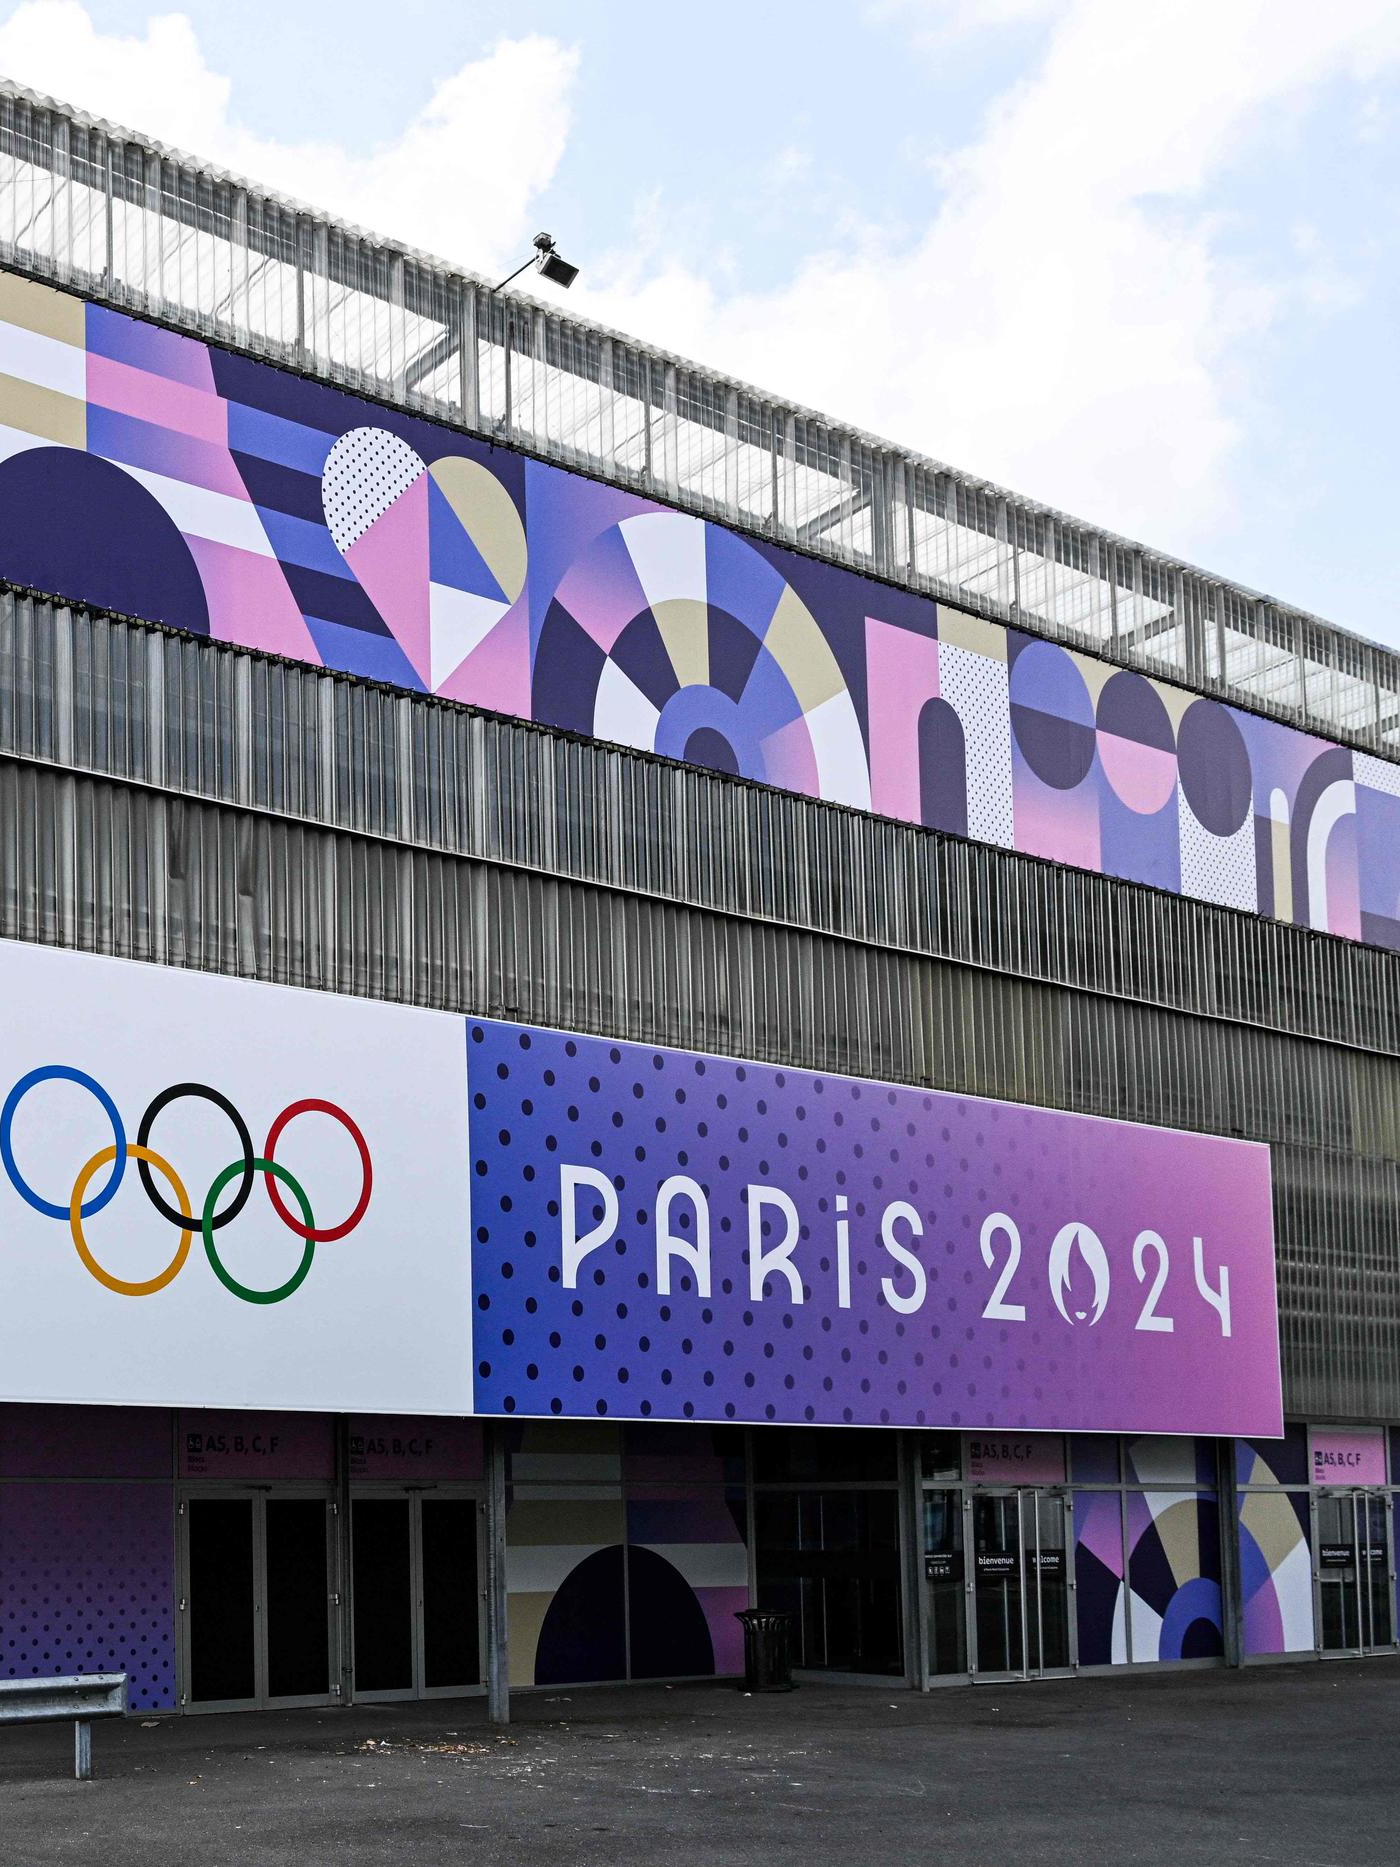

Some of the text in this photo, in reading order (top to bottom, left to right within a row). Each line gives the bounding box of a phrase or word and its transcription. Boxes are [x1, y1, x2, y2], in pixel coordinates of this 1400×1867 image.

[980, 1212, 1232, 1337] 2024
[234, 1436, 249, 1455] B,
[252, 1436, 266, 1456] C,
[270, 1436, 280, 1453] F
[425, 1438, 433, 1454] F
[1026, 1444, 1033, 1459] F
[1356, 1453, 1362, 1466] F
[978, 1556, 1014, 1565] bienvenue
